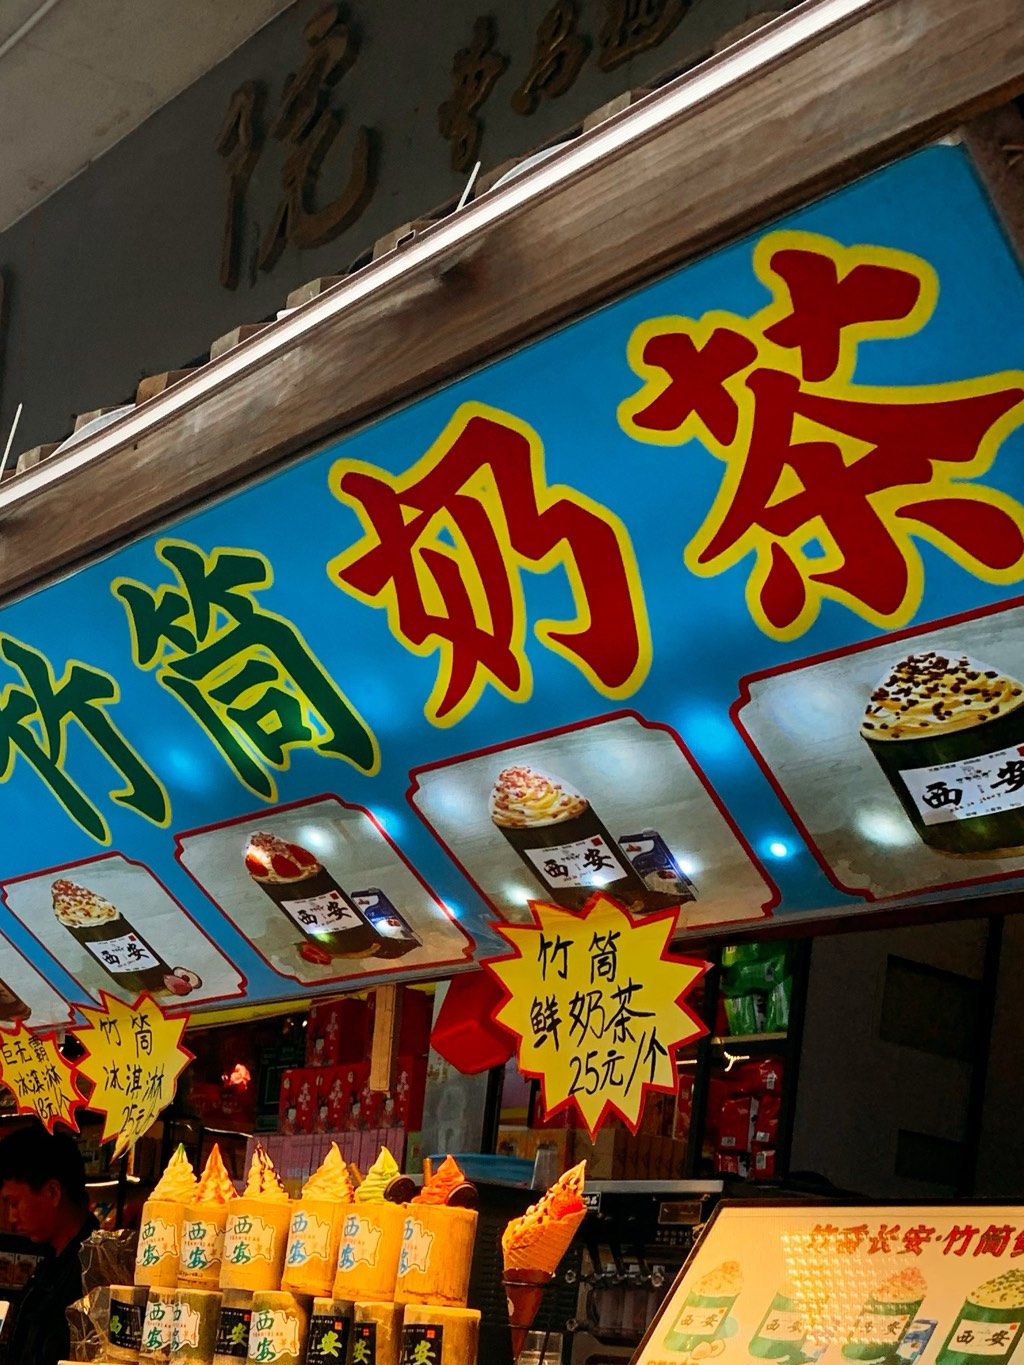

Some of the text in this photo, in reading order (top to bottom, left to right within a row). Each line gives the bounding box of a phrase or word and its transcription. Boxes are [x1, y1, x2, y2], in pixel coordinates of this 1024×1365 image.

[544, 849, 614, 878] 西安
[298, 901, 352, 925] 西安
[101, 942, 149, 966] 西安
[538, 930, 621, 984] 竹筒
[100, 1013, 152, 1057] 竹筒
[530, 977, 656, 1051] 鲜奶茶
[1, 1035, 48, 1066] 巨无霸
[568, 1027, 667, 1097] 25元/个
[14, 1065, 62, 1097] 冰淇淋
[103, 1061, 164, 1101] 冰淇淋
[142, 1221, 160, 1266] 西安
[187, 1222, 209, 1269] 西安
[231, 1215, 252, 1264] 西安
[288, 1213, 307, 1263] 西安
[339, 1216, 359, 1269] 西安
[146, 1303, 165, 1349] 西安
[256, 1310, 276, 1362] 西安
[317, 1331, 342, 1357] 安
[956, 1330, 1012, 1346] 西安
